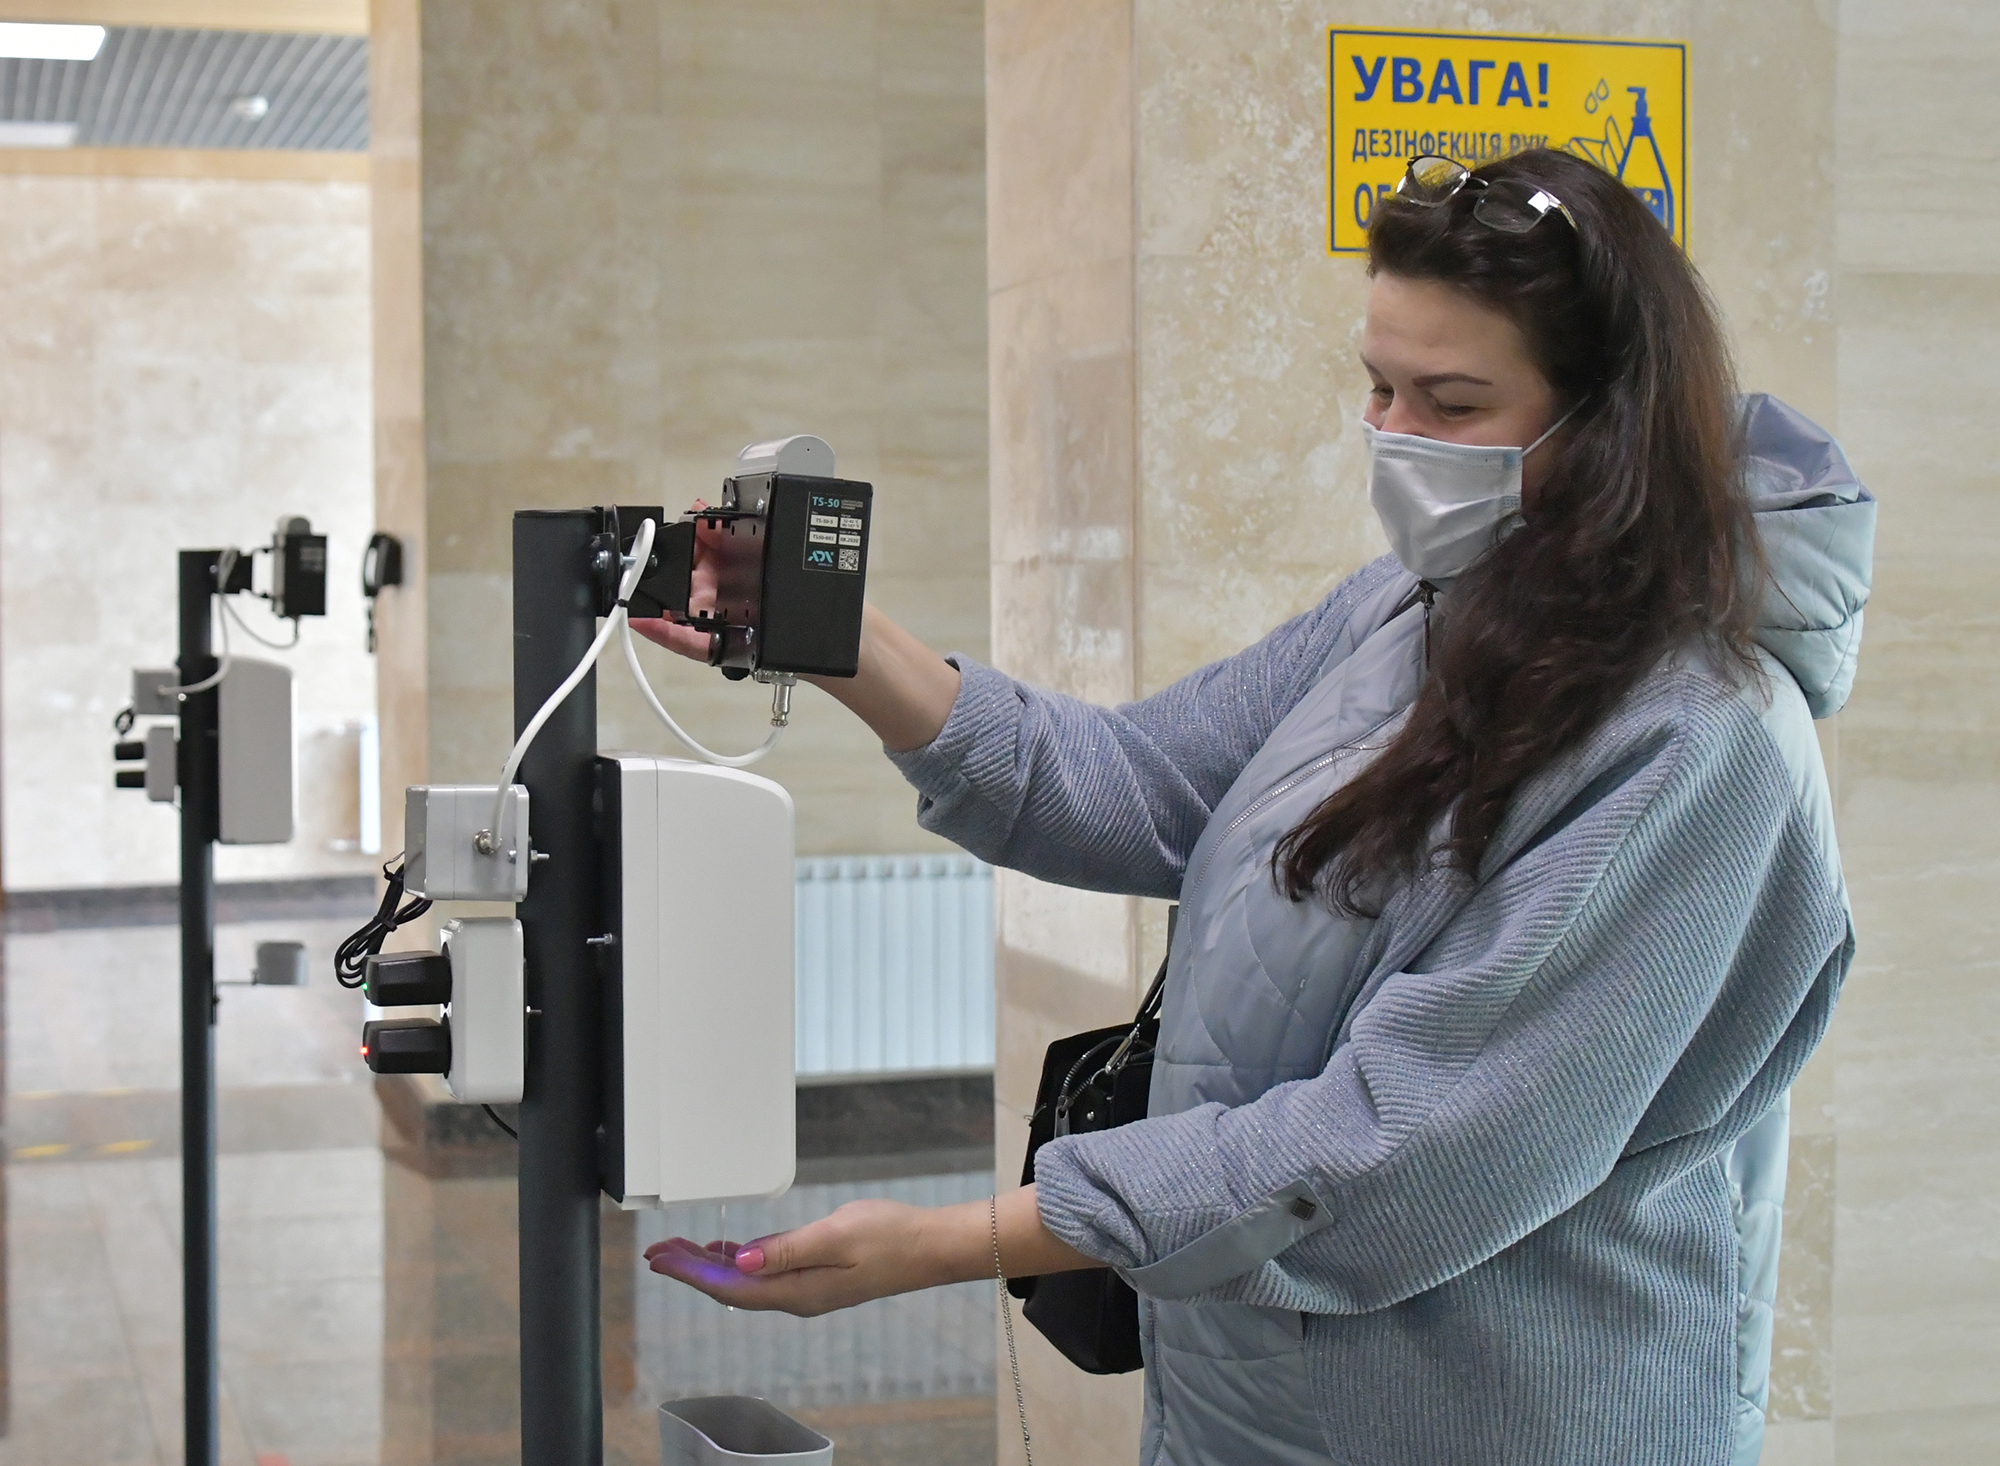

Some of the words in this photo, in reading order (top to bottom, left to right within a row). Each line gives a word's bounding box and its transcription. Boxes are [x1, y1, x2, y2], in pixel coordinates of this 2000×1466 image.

[1351, 55, 1549, 108] УВАГА!
[1352, 128, 1502, 162] ДЕЗІНФЕКЦІЯ
[812, 496, 840, 508] TS-50
